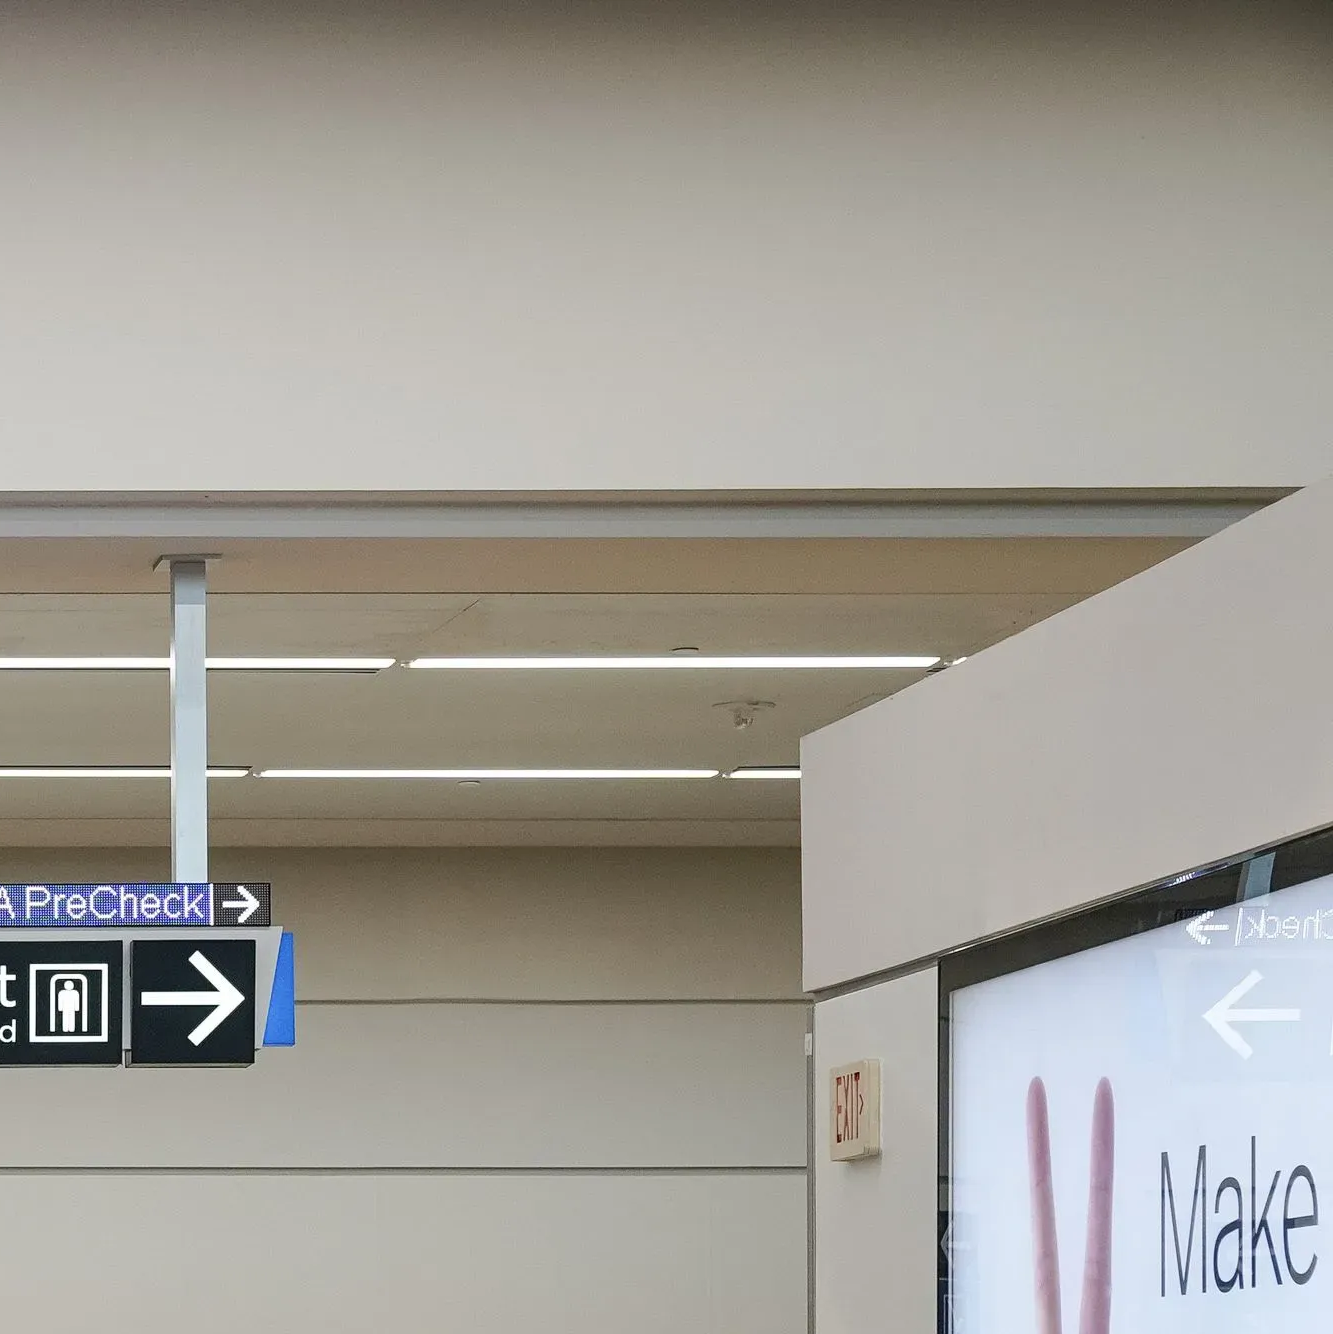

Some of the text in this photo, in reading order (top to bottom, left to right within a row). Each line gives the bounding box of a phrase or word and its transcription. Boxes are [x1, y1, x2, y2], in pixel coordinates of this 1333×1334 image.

[25, 887, 201, 922] PreCheck
[835, 1070, 861, 1145] EXIT
[1160, 1134, 1320, 1298] Make
